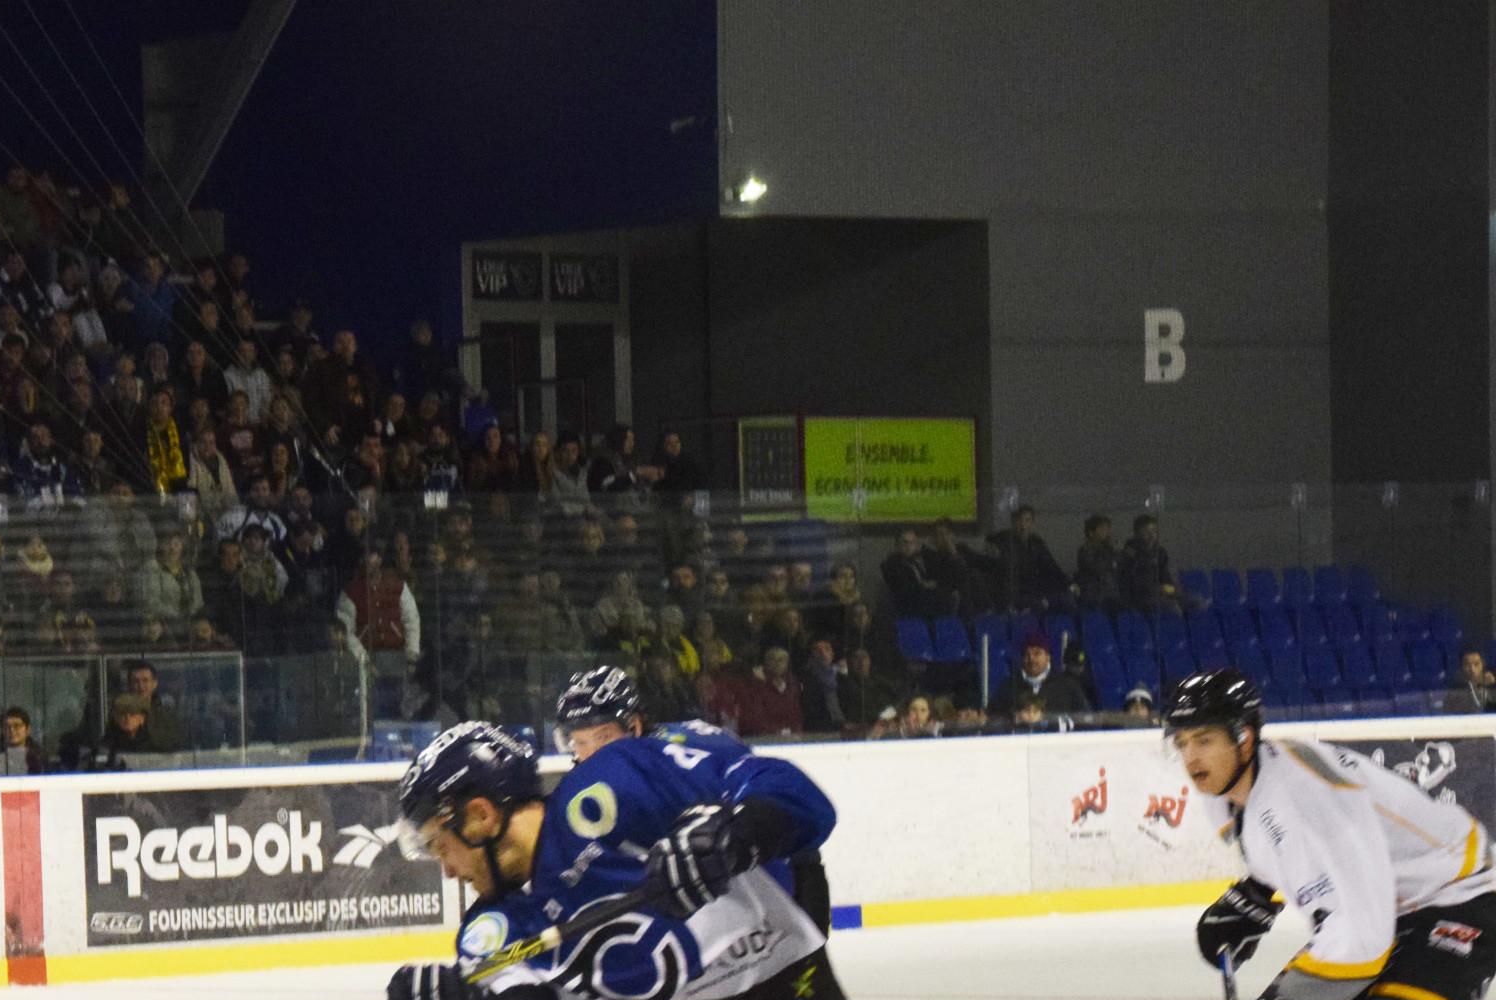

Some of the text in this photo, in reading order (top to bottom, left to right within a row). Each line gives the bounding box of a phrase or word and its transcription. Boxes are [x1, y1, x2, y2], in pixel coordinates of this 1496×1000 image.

[477, 272, 508, 294] VIP
[555, 273, 585, 296] VIP
[1143, 308, 1186, 384] B
[95, 810, 324, 898] Reebok
[149, 908, 255, 933] FOURNISSEUR
[258, 900, 327, 926] EXCLUSIF
[329, 898, 359, 921] DES
[360, 893, 441, 918] CORSAIRES
